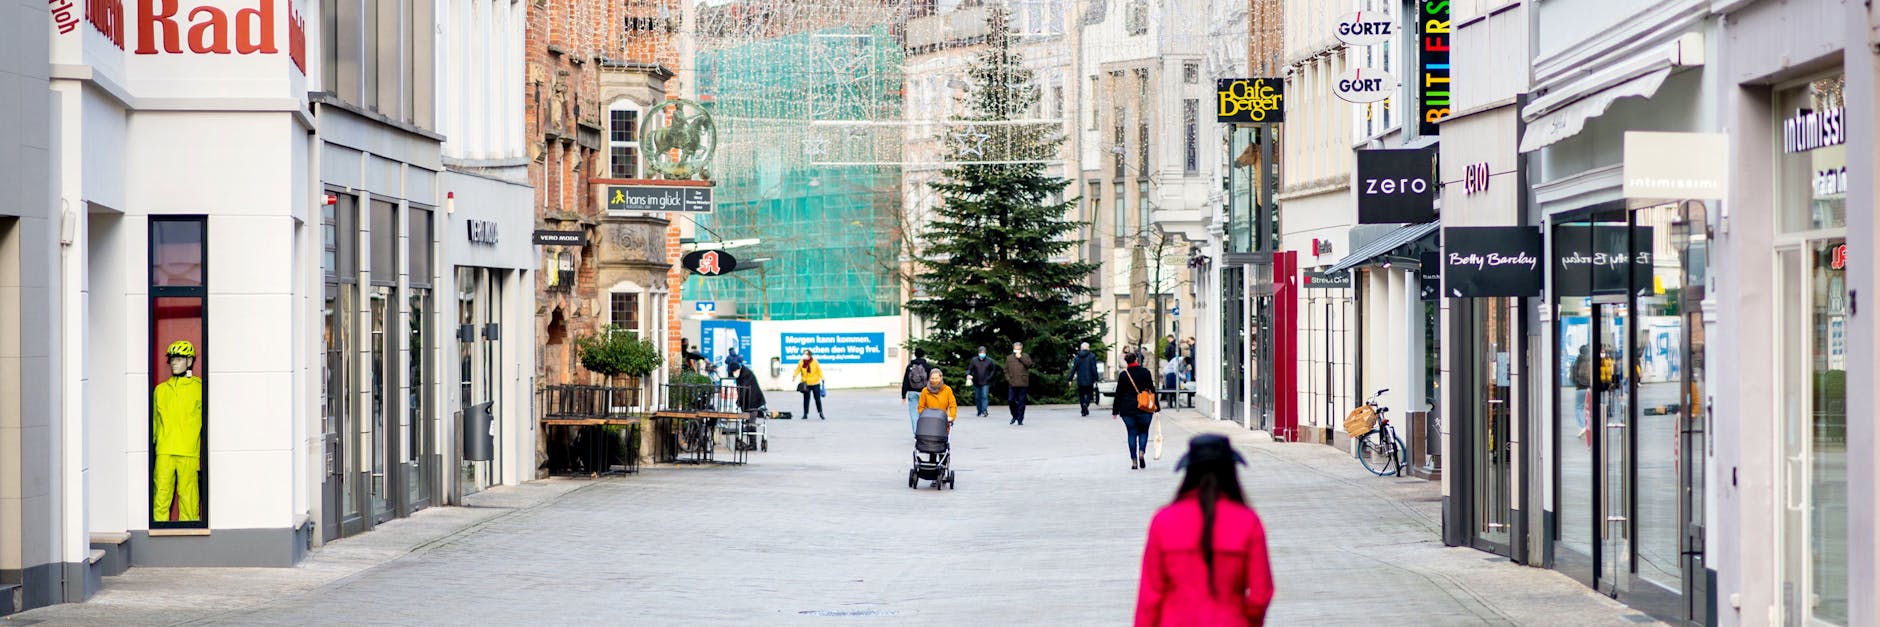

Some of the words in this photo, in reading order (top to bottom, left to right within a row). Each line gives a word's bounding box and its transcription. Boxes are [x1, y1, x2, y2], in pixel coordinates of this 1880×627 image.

[135, 0, 278, 55] Rad
[1218, 91, 1282, 121] Berger
[1366, 178, 1426, 194] zero
[1463, 162, 1489, 195] zero
[626, 190, 646, 206] hans
[648, 195, 658, 205] im
[660, 191, 681, 209] glück
[1449, 252, 1483, 271] Betty
[1486, 252, 1537, 271] Barclay
[785, 336, 815, 345] Morgen
[816, 335, 835, 343] kann
[836, 335, 871, 343] kommen.
[847, 346, 864, 354] Weg
